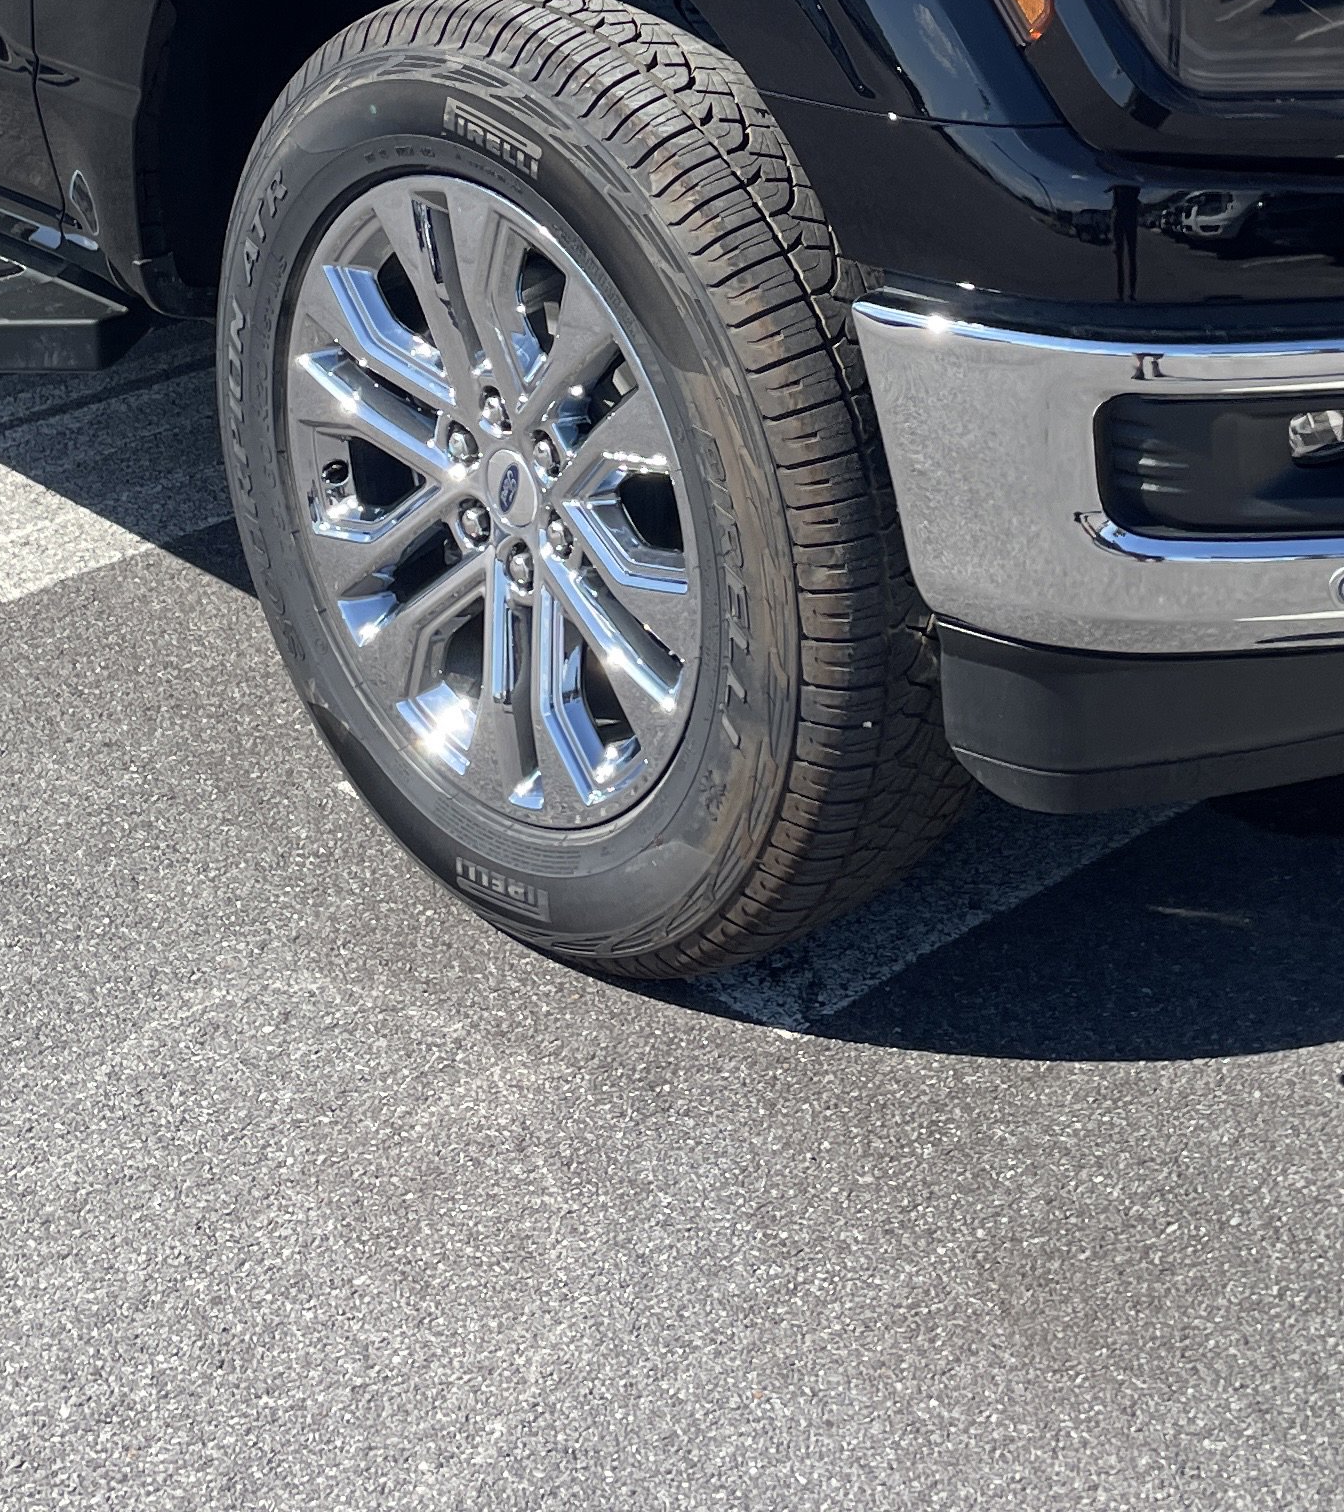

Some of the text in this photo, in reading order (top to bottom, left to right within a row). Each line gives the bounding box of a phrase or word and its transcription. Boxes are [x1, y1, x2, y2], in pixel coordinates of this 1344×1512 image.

[443, 96, 542, 181] PIRELLI
[243, 167, 288, 288] ATR
[690, 424, 752, 751] PIRELLI
[455, 856, 553, 924] PIRELLI
